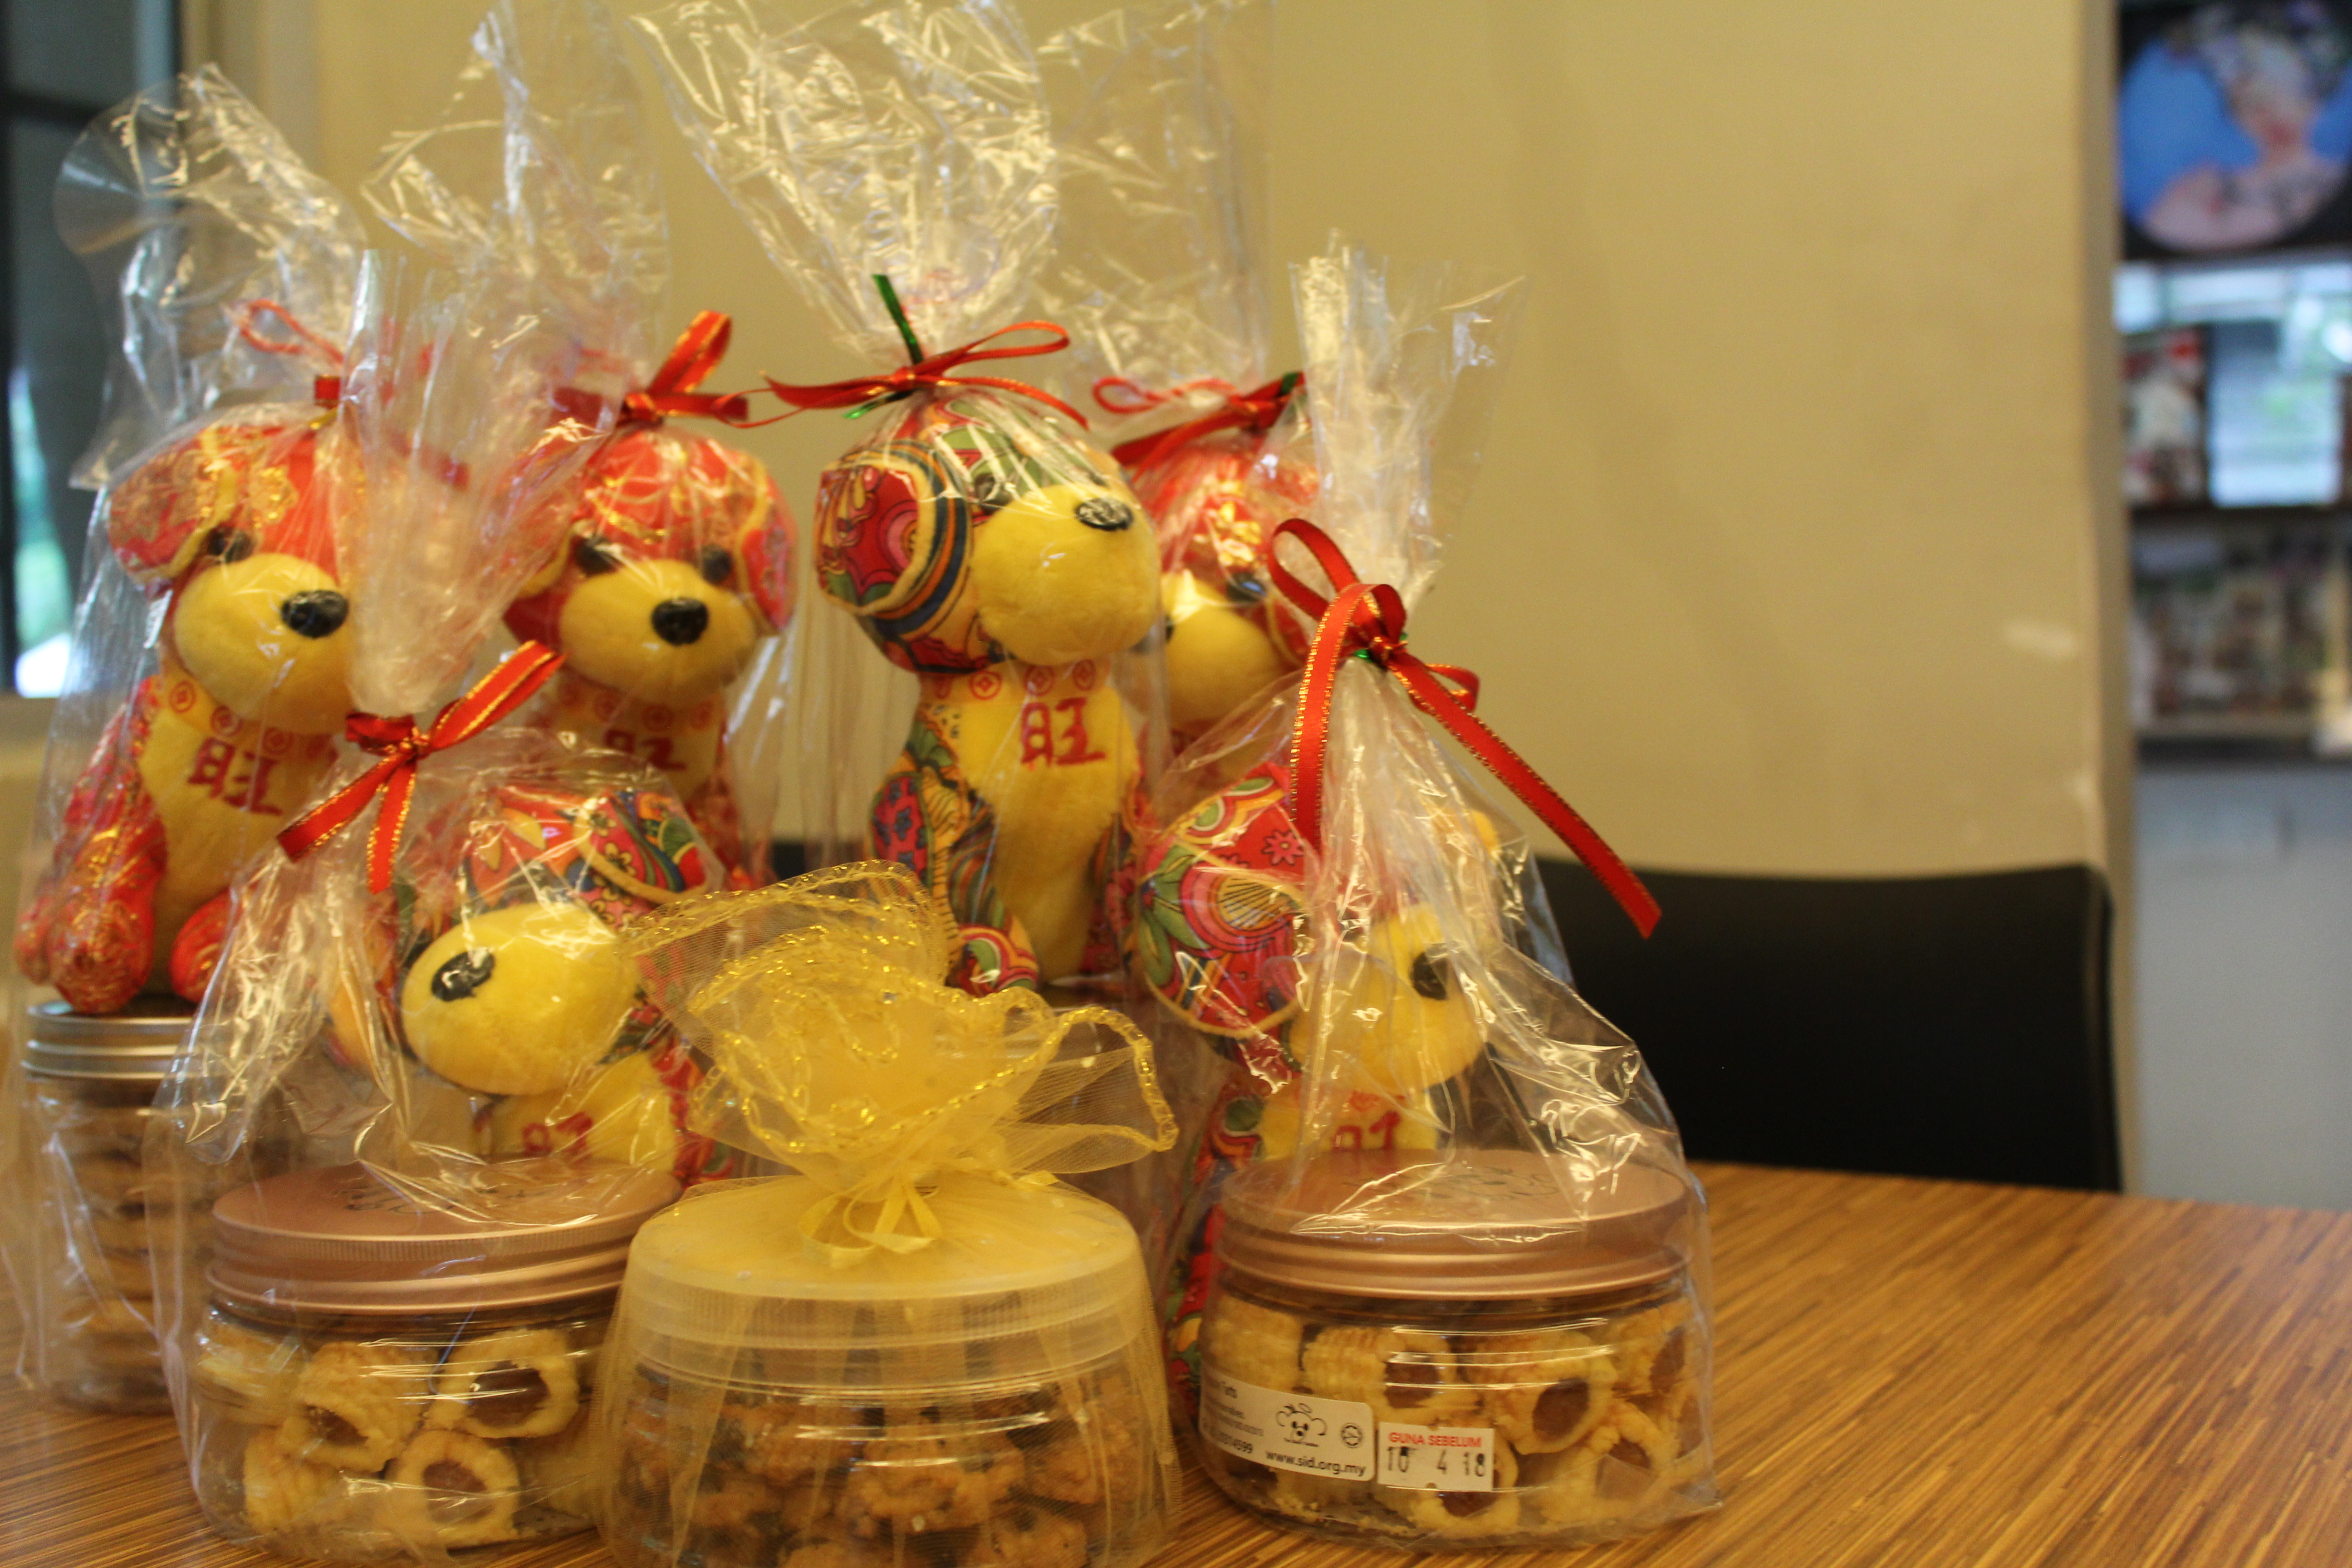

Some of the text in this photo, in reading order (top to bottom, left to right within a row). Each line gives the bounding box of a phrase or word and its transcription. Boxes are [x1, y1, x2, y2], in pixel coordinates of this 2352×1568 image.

[1021, 697, 1107, 767] 旺
[1388, 1432, 1482, 1447] GUNA SEBELUM
[1265, 1451, 1367, 1477] www.sid.org.my
